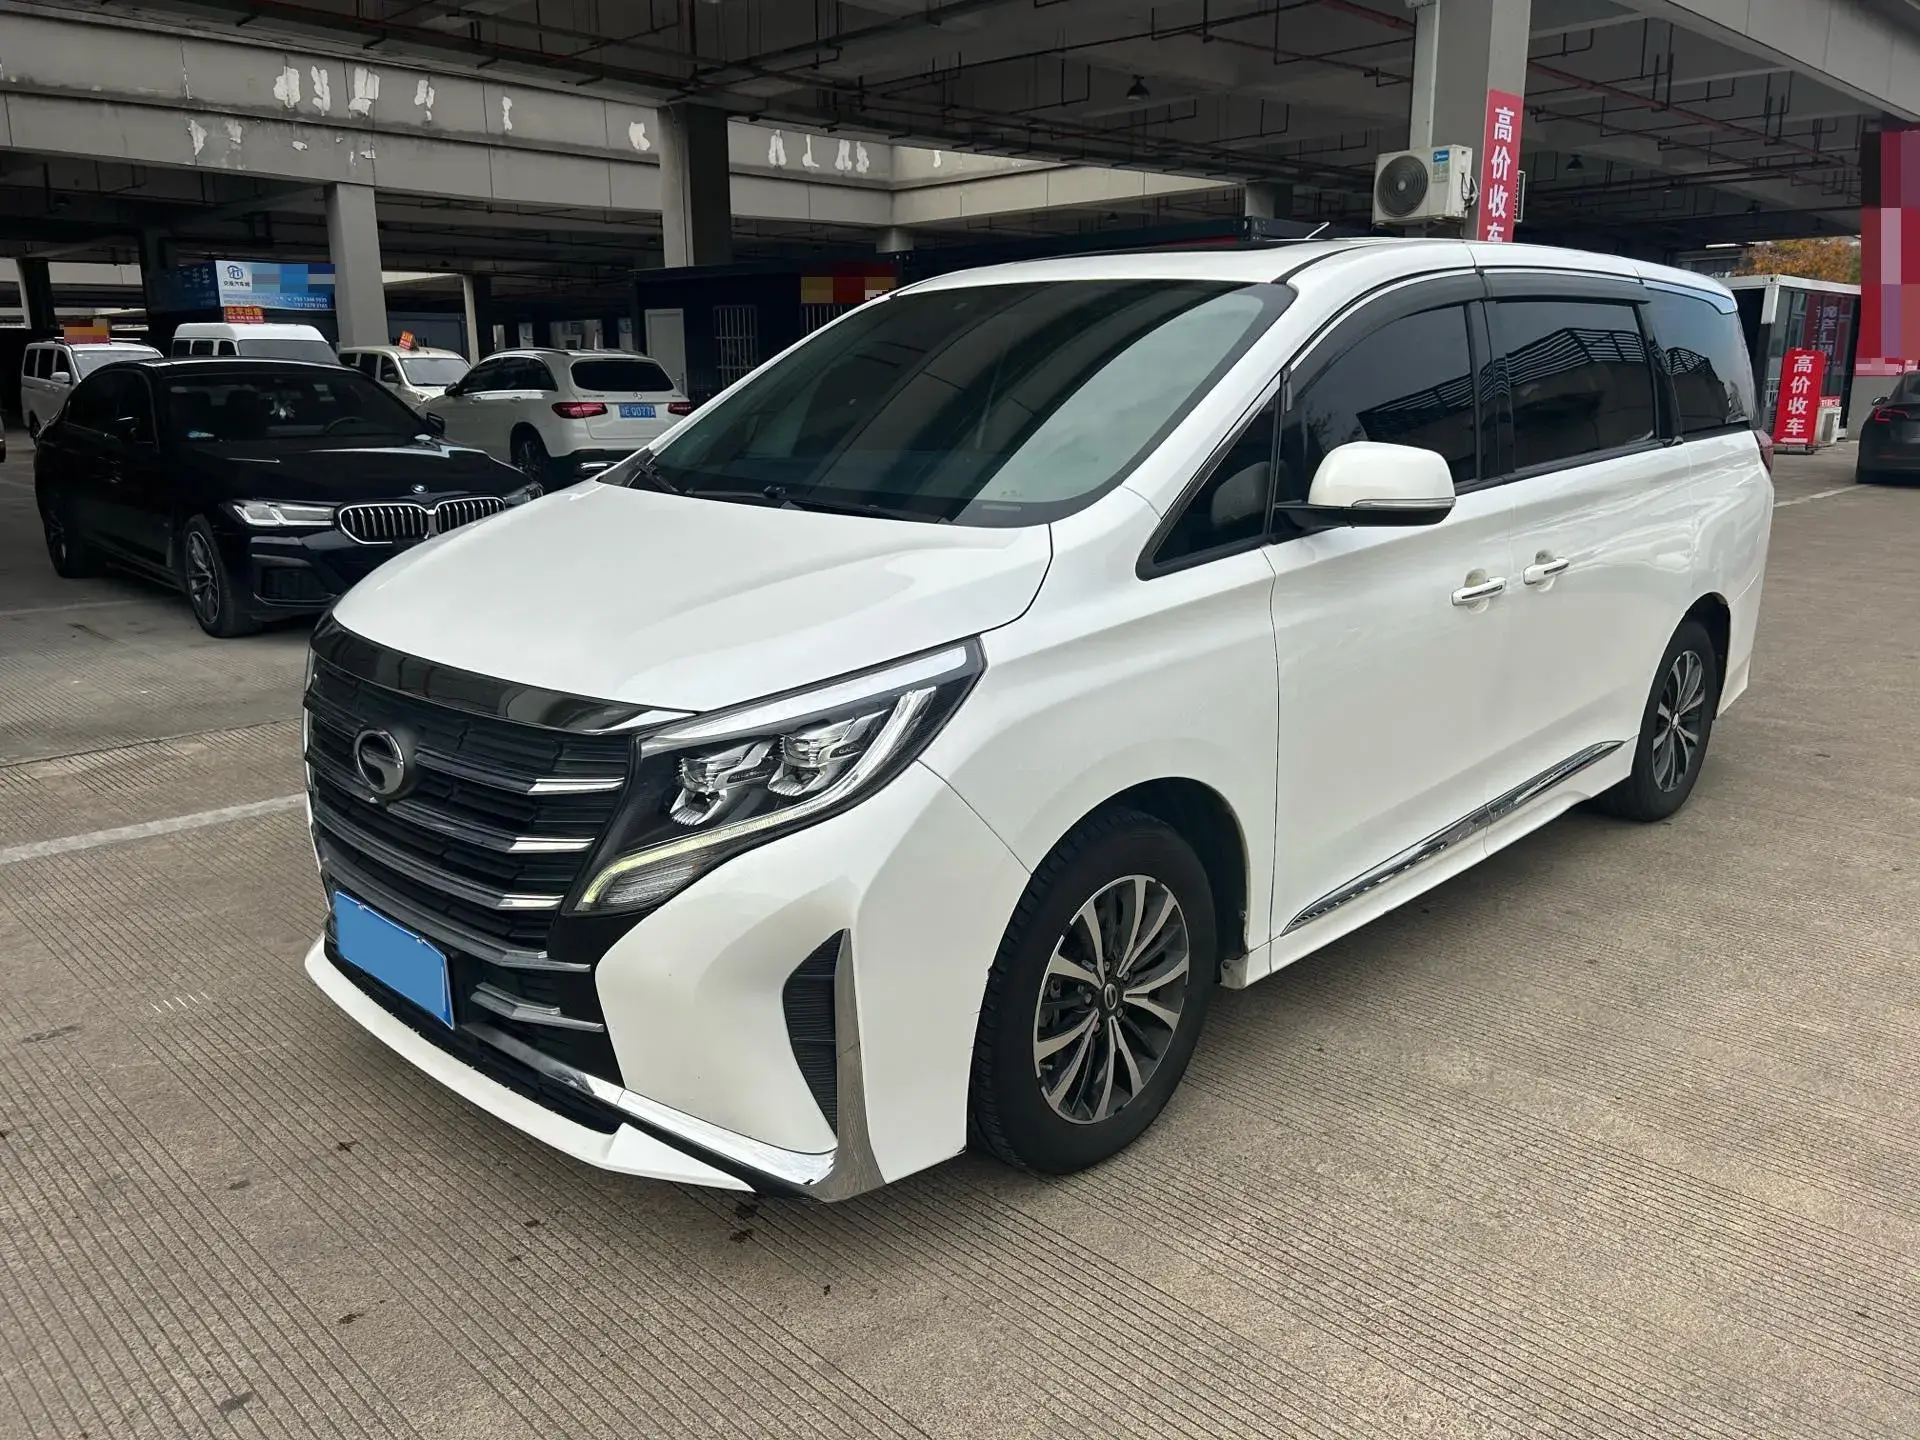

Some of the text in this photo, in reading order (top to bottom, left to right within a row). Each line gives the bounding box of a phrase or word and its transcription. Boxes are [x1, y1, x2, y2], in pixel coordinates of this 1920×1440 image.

[1487, 106, 1515, 242] 高价收车
[1784, 354, 1815, 436] 高价收车
